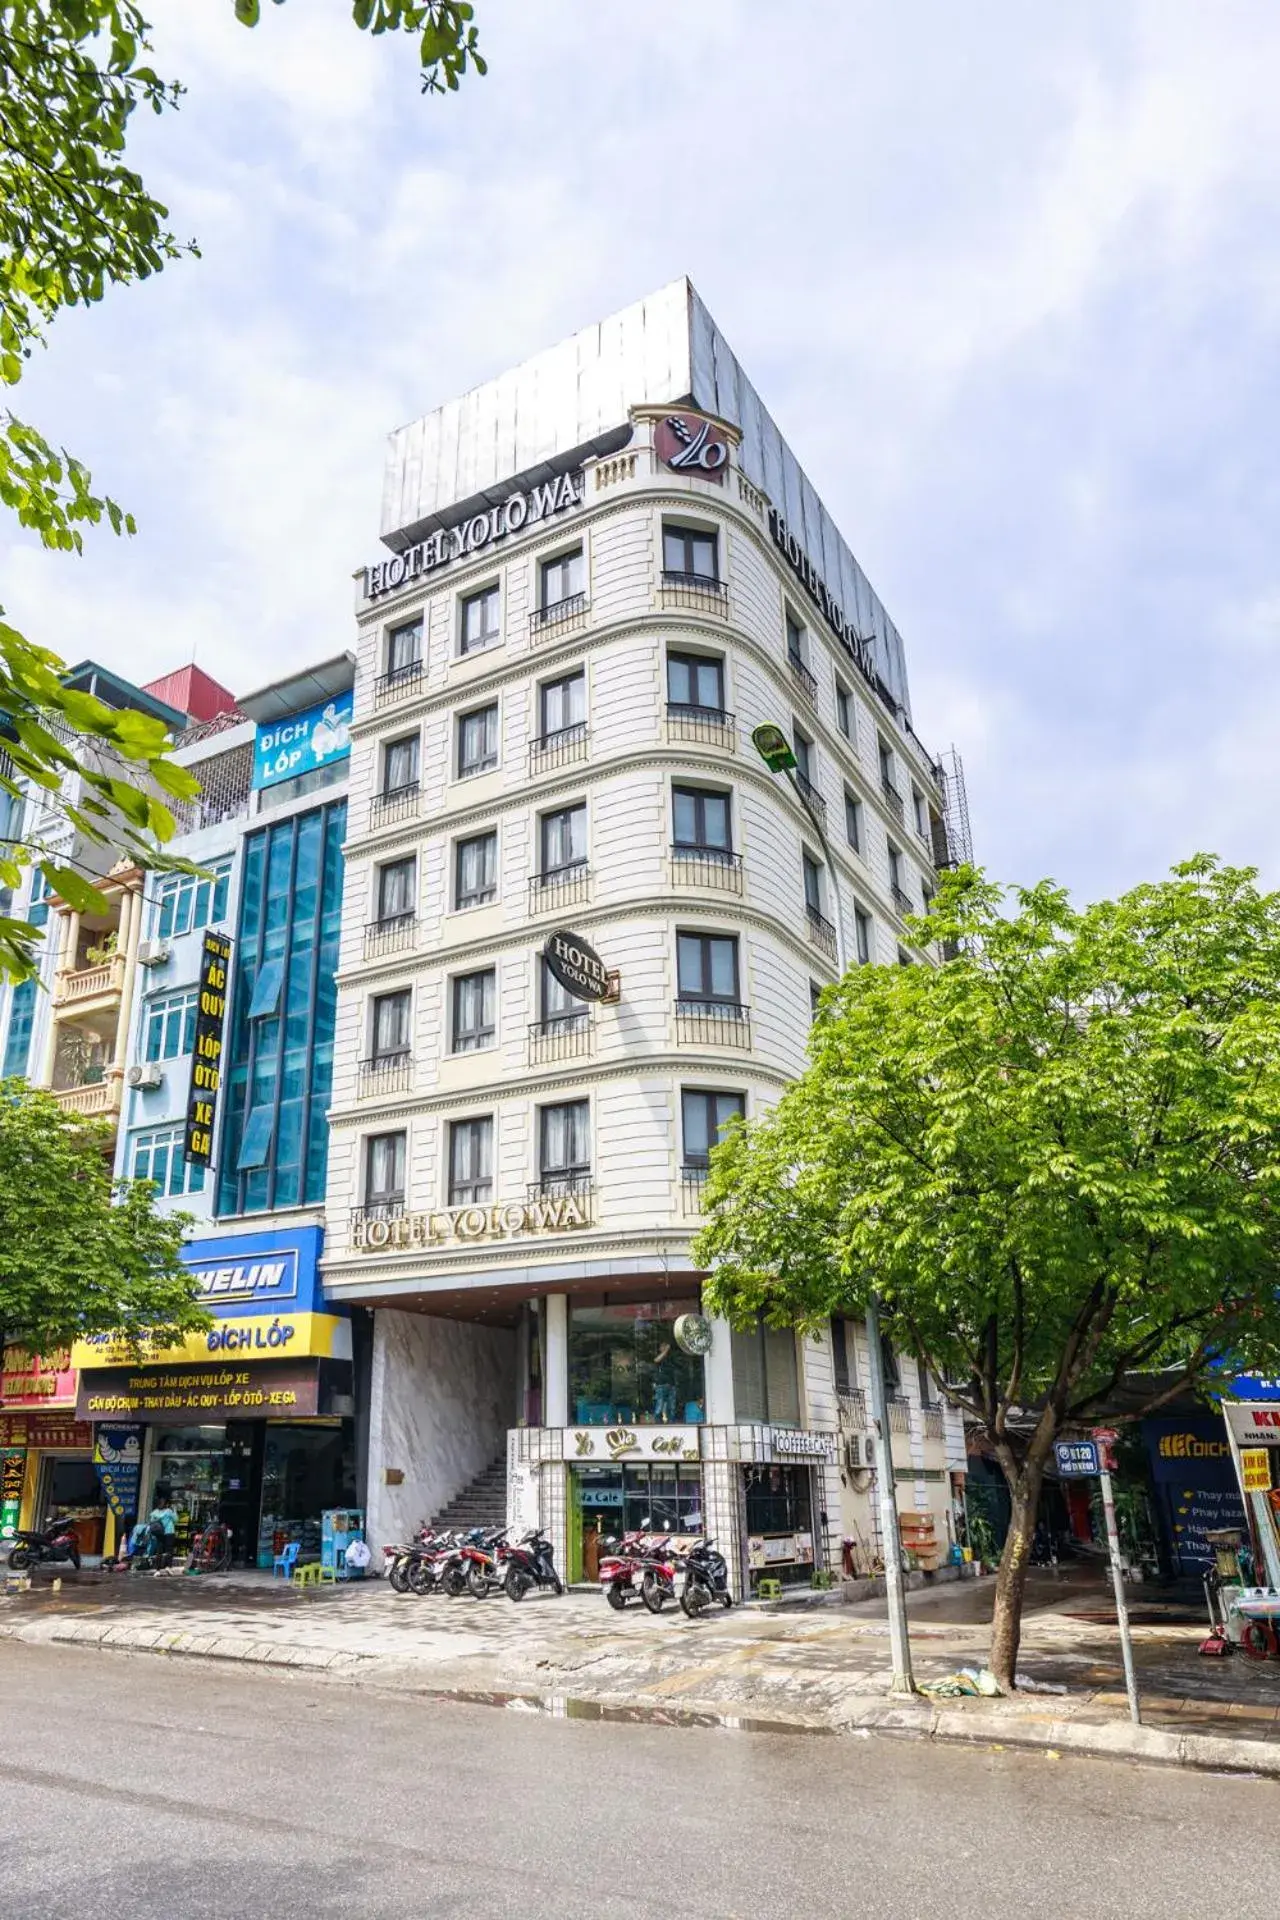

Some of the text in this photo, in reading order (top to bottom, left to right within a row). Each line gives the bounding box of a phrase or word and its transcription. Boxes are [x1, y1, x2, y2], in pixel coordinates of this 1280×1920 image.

[367, 530, 448, 598] HOTEL
[260, 720, 309, 753] ĐÍCH
[263, 748, 302, 778] LỐP
[554, 936, 609, 985] HOTEL
[560, 961, 603, 995] YOLO WA
[201, 991, 226, 1018] QUY
[198, 1031, 221, 1060] LỐP
[196, 1101, 213, 1126] XE
[191, 1130, 210, 1156] GA
[350, 1212, 438, 1247] HOTEL
[207, 1317, 295, 1352] ĐÍCH LỐP
[129, 1378, 158, 1389] TRUNG
[214, 1369, 234, 1386] LỐP
[235, 1372, 251, 1385] XE
[144, 1396, 165, 1409] THAY
[200, 1394, 220, 1408] QUY
[223, 1388, 242, 1407] LỐP
[269, 1391, 283, 1405] XE
[282, 1390, 297, 1405] GA
